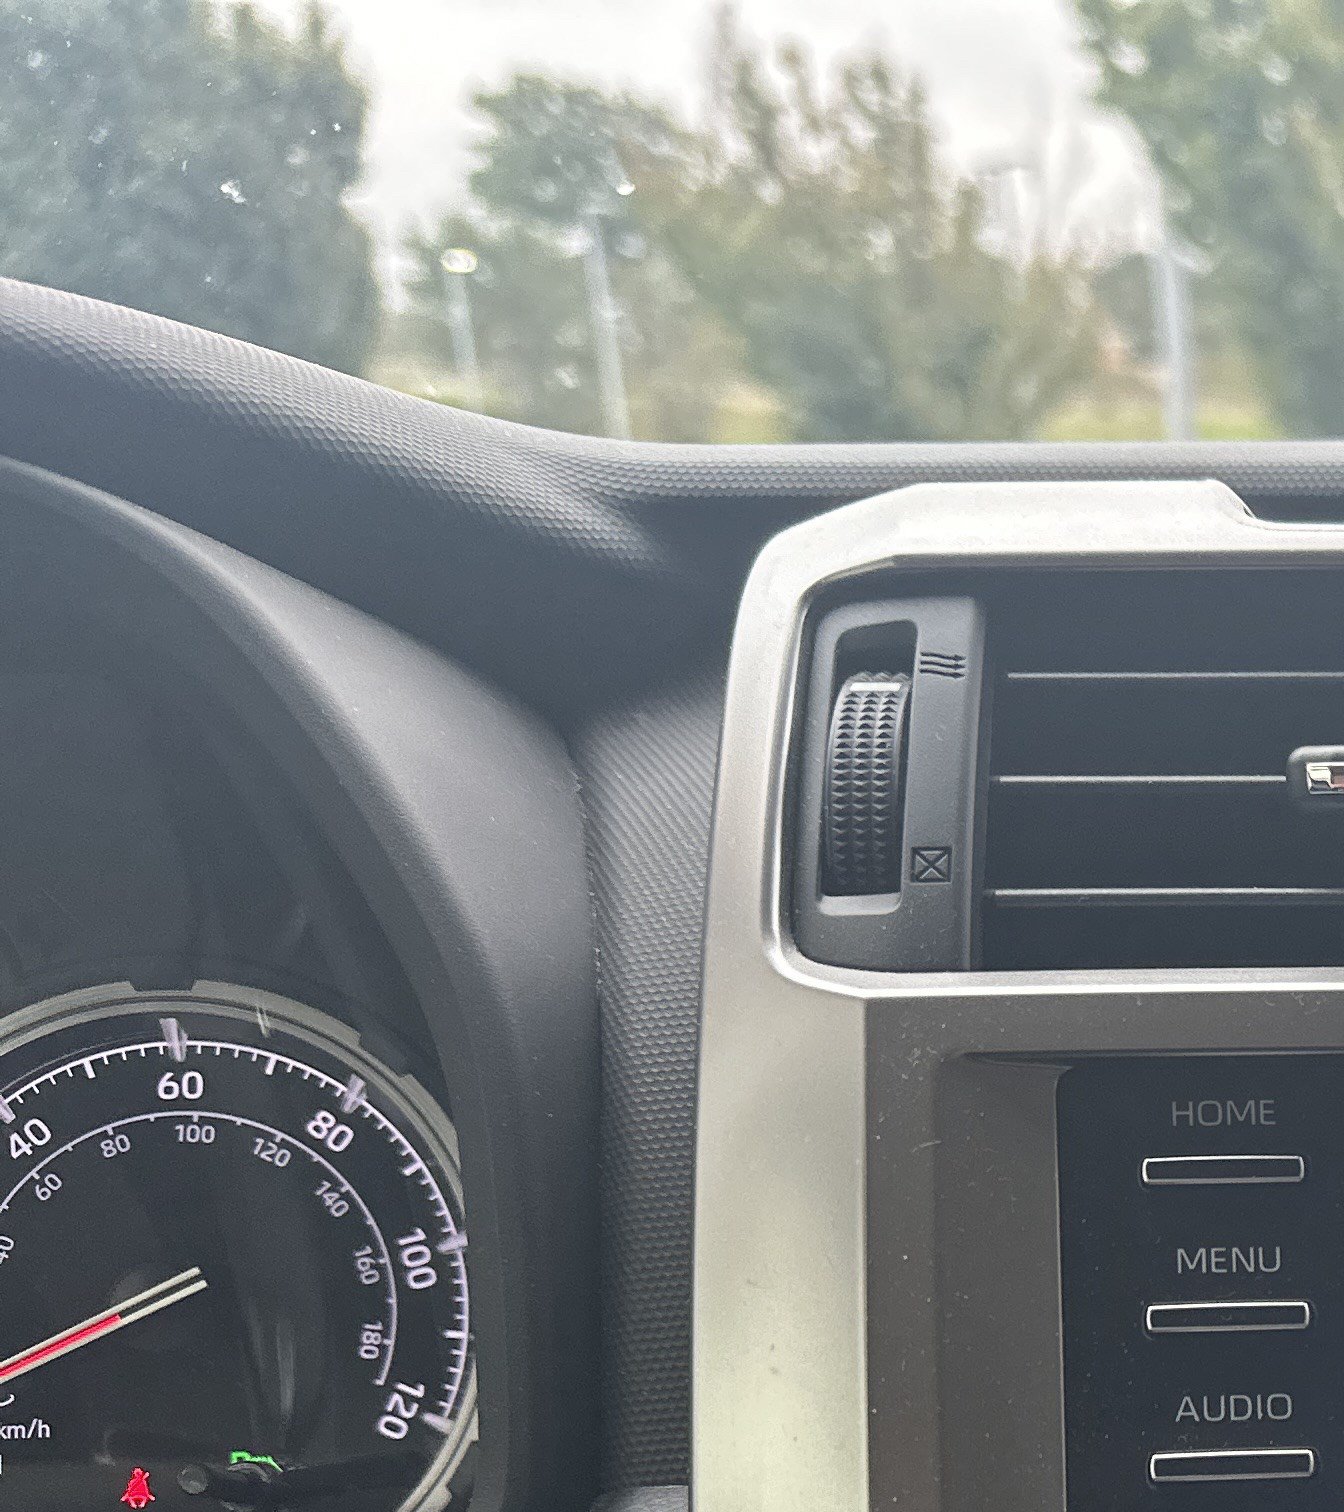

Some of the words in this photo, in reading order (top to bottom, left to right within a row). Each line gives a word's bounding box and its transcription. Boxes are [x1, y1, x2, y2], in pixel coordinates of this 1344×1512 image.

[157, 1072, 204, 1100] 60
[1171, 1099, 1276, 1128] HOME
[7, 1117, 52, 1160] 40
[100, 1133, 131, 1158] 80
[175, 1124, 216, 1144] 100
[306, 1110, 355, 1153] 80
[251, 1136, 292, 1168] 120
[34, 1173, 63, 1201] 60
[316, 1180, 349, 1217] 140
[354, 1244, 380, 1286] 160
[398, 1227, 438, 1291] 100
[1177, 1246, 1282, 1274] MENU
[358, 1321, 383, 1361] 180
[378, 1380, 426, 1440] 120
[1175, 1393, 1293, 1422] AUDIO
